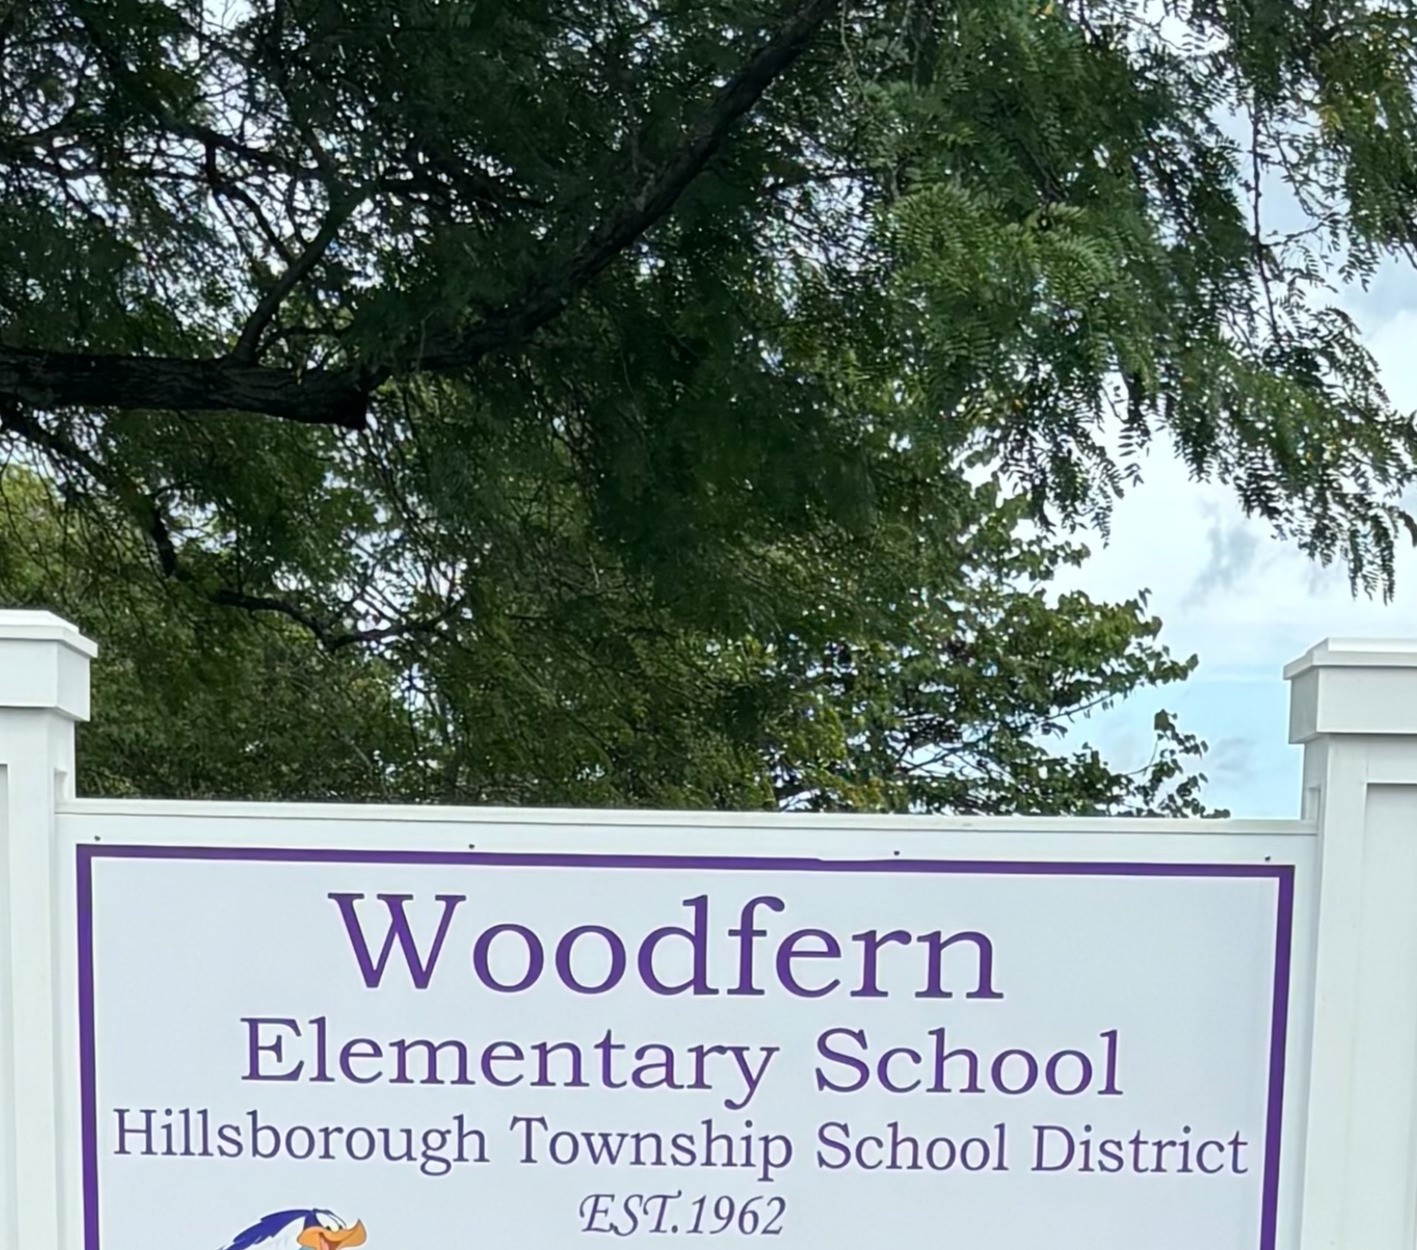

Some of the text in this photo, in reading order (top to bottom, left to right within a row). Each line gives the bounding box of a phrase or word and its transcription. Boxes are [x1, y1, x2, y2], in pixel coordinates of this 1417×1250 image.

[327, 892, 1005, 999] Woodfern
[240, 1016, 1124, 1110] Elementary School
[113, 1108, 1249, 1182] Hillsborough Township School District
[578, 1189, 787, 1237] EST.1962
